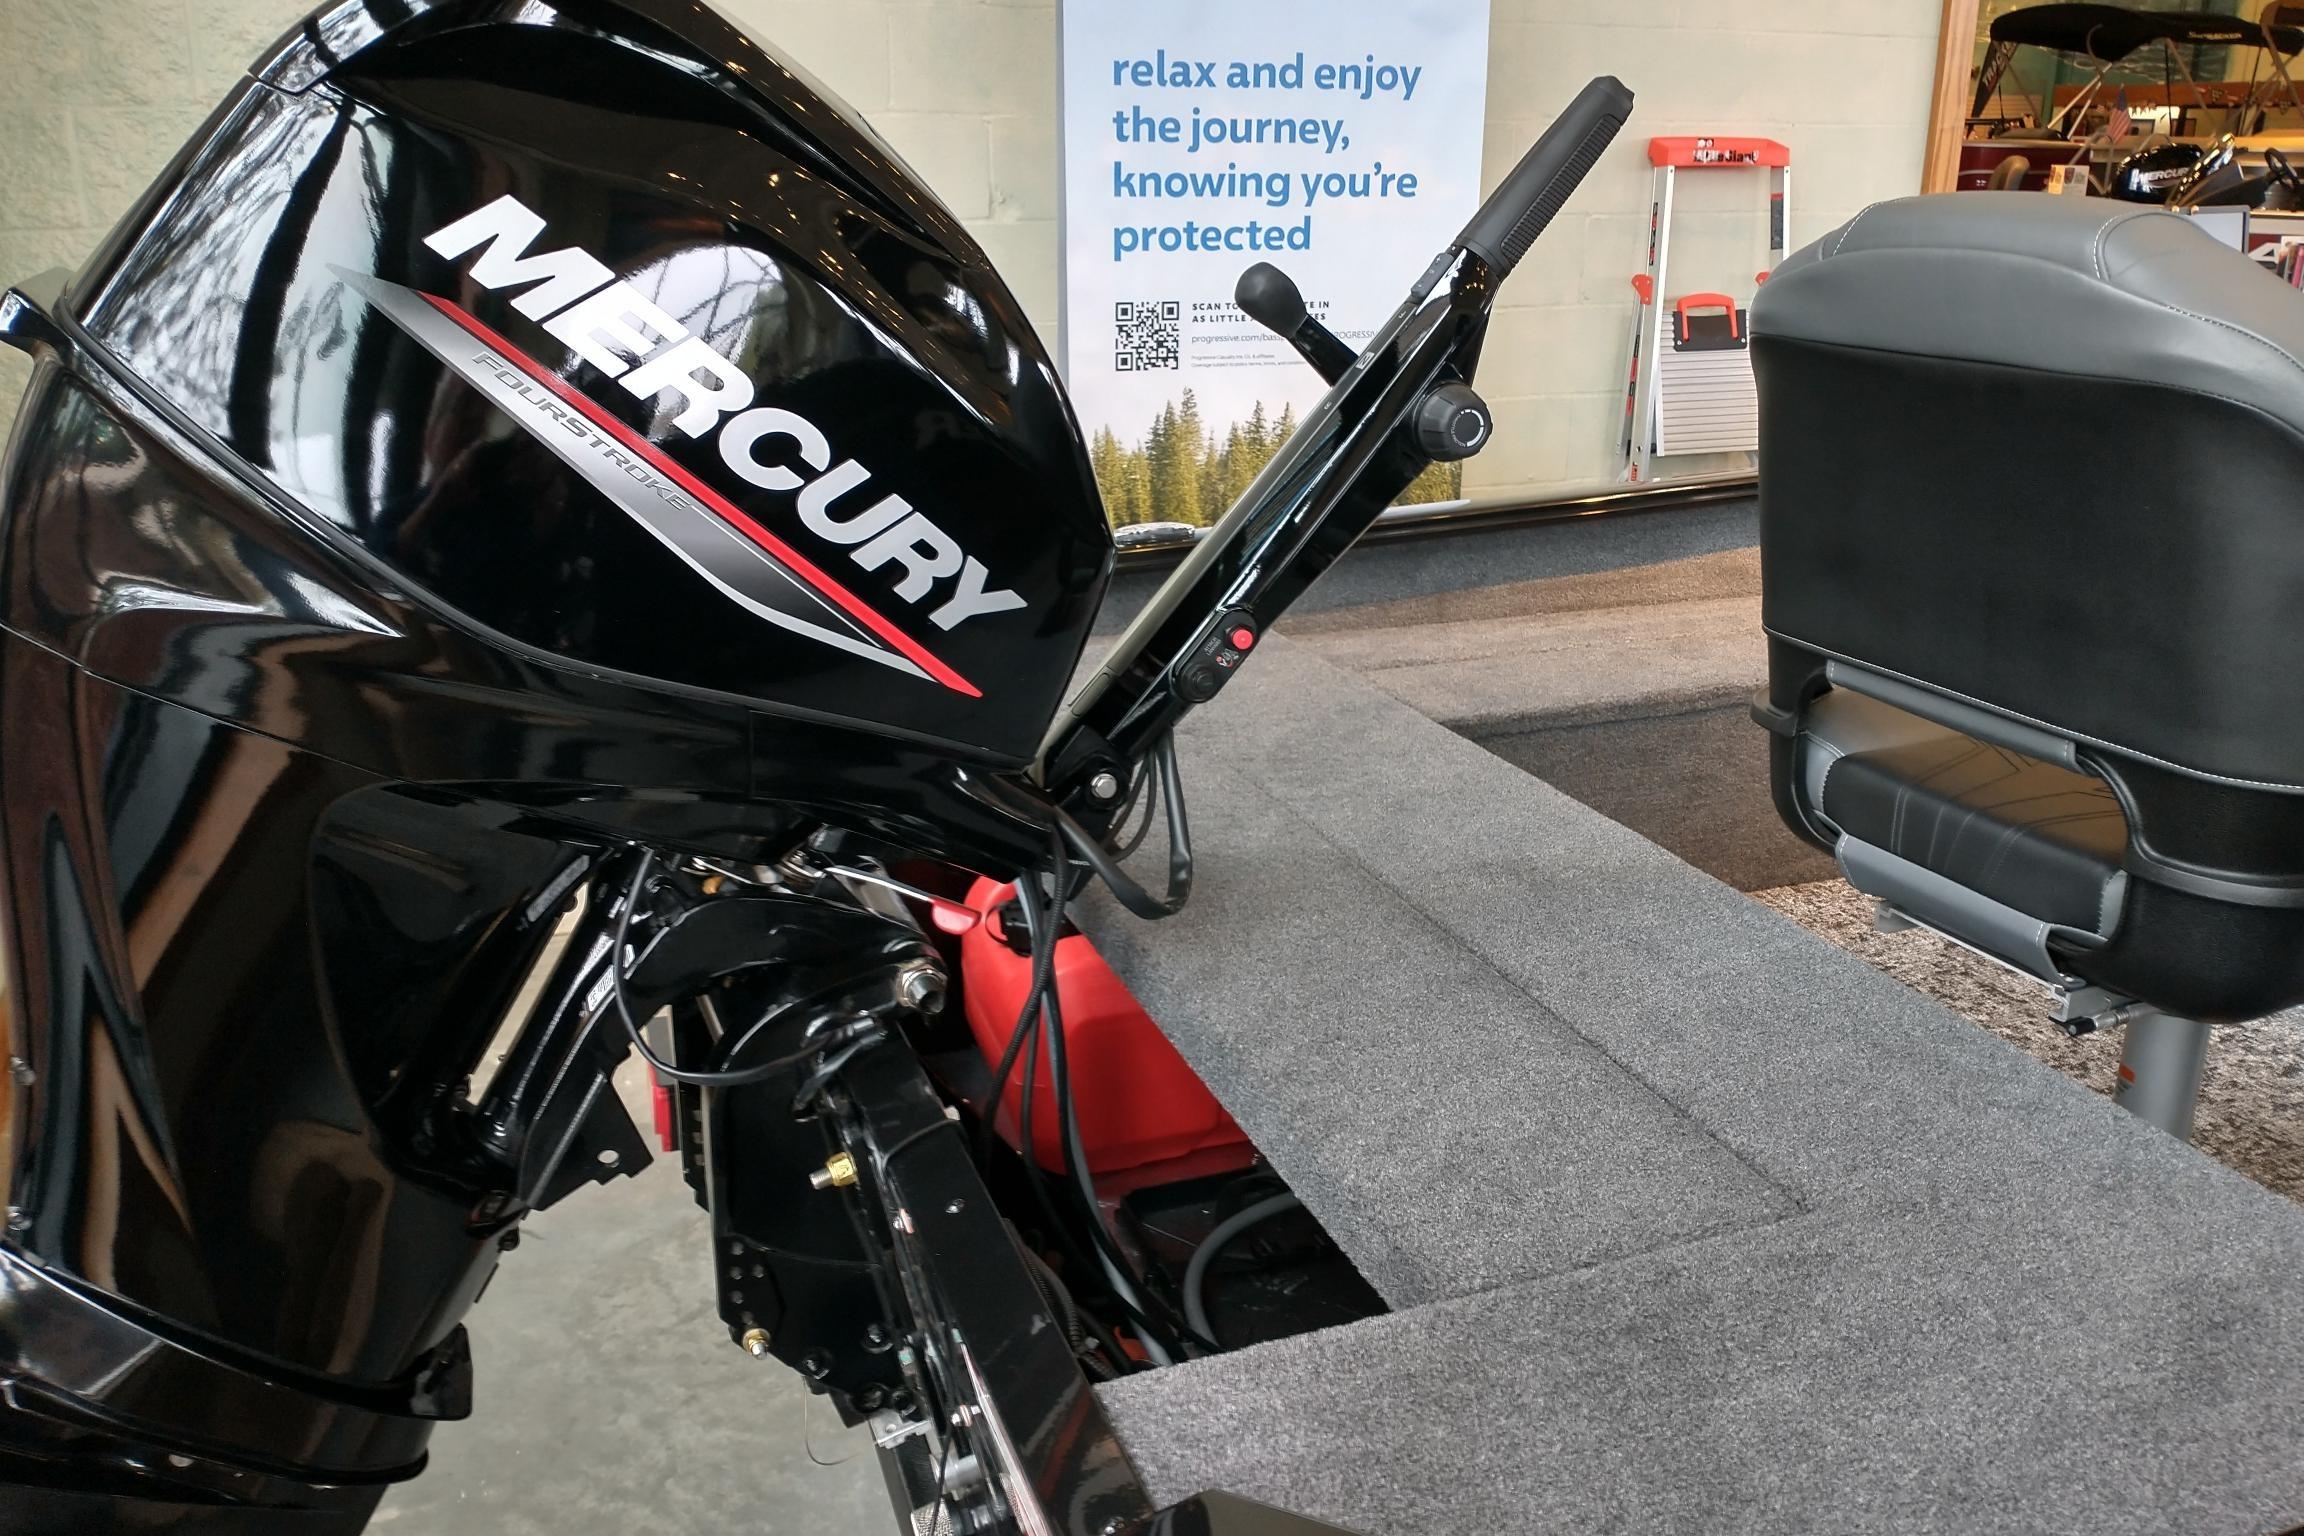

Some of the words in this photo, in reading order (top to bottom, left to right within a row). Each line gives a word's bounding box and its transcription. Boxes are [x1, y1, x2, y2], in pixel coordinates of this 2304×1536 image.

[1113, 48, 1216, 88] relax
[1226, 52, 1304, 89] and
[1314, 55, 1422, 100] enjoy
[1112, 105, 1181, 143] the
[1187, 107, 1350, 153] journey,
[1113, 161, 1291, 207] knowing
[1300, 162, 1418, 207] you're
[1113, 216, 1311, 261] protected
[1192, 303, 1221, 311] SCAN
[1318, 301, 1330, 309] IN
[1192, 315, 1206, 323] AS
[1210, 314, 1246, 323] LITTLE
[422, 194, 1028, 631] MERCURY
[471, 351, 691, 511] FOURSTROKE
